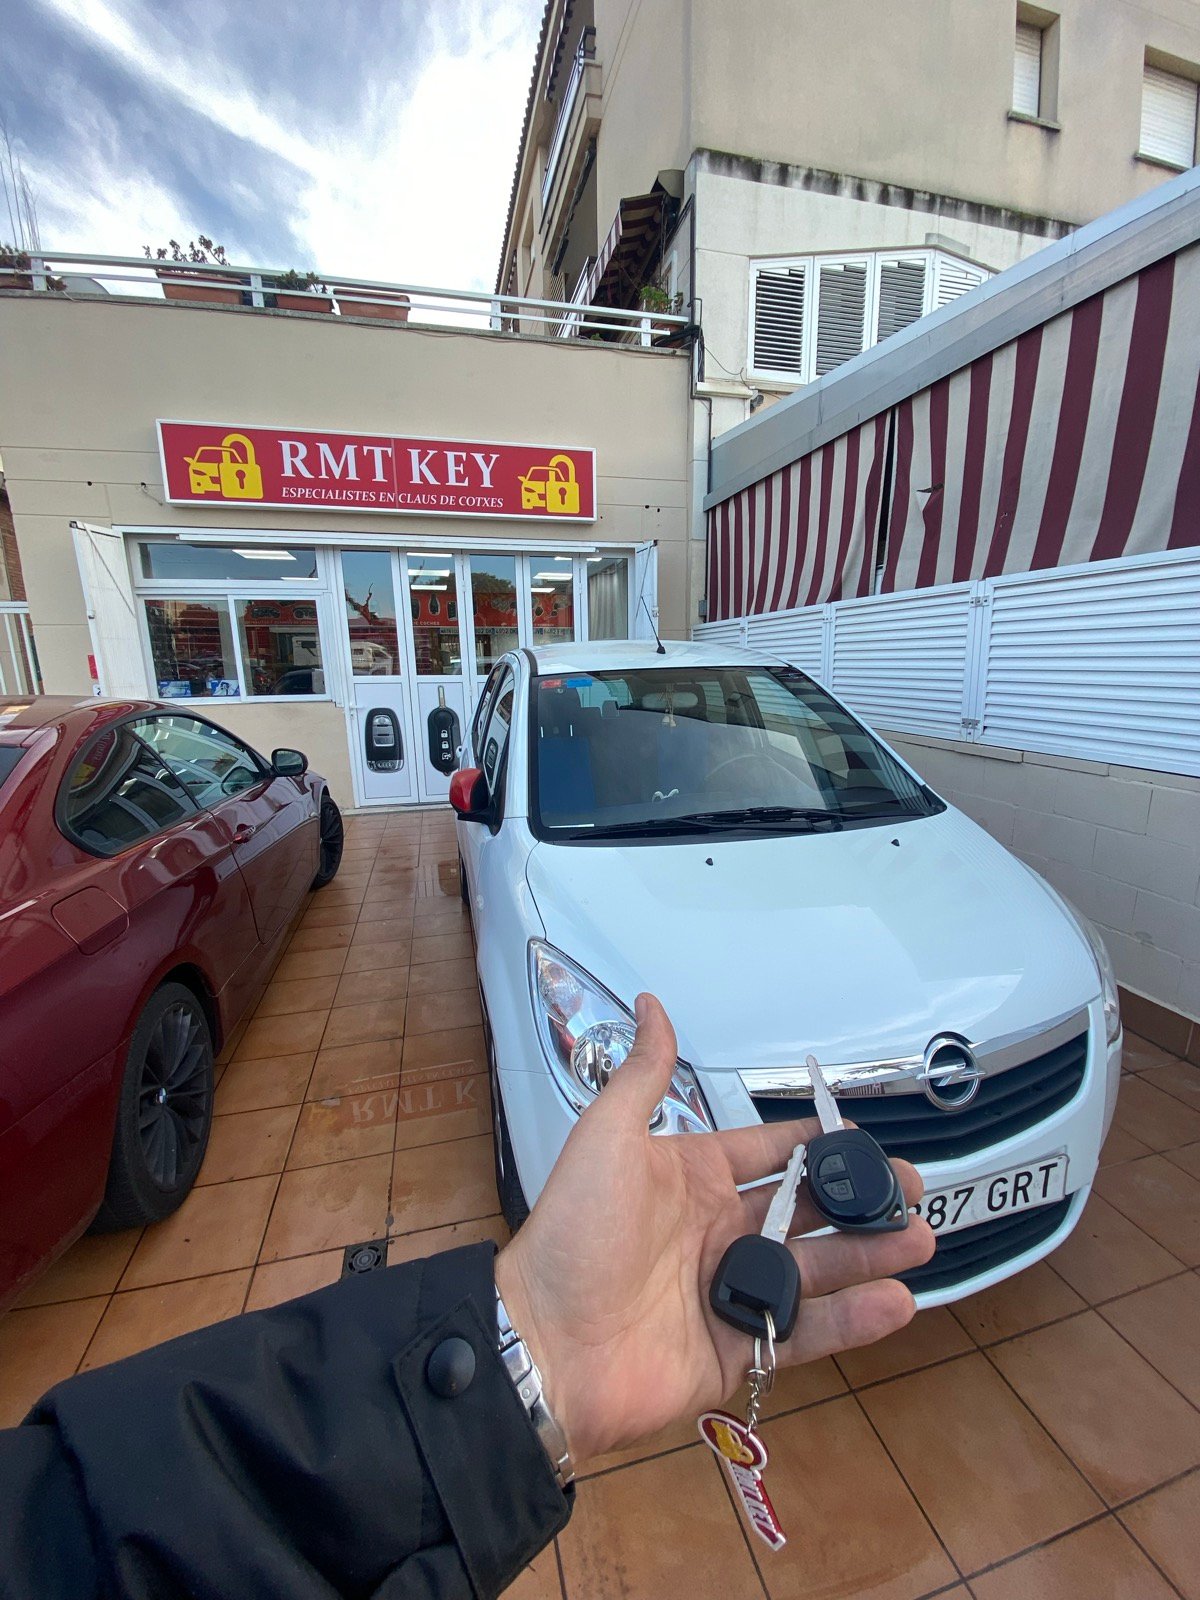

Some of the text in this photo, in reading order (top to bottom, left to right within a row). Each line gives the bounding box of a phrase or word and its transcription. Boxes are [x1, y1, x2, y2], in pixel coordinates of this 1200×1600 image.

[278, 440, 500, 488] RMT KEY
[282, 486, 504, 508] ESPECIALISTES EN CLAUS DE COTXES
[987, 1162, 1058, 1212] GRT
